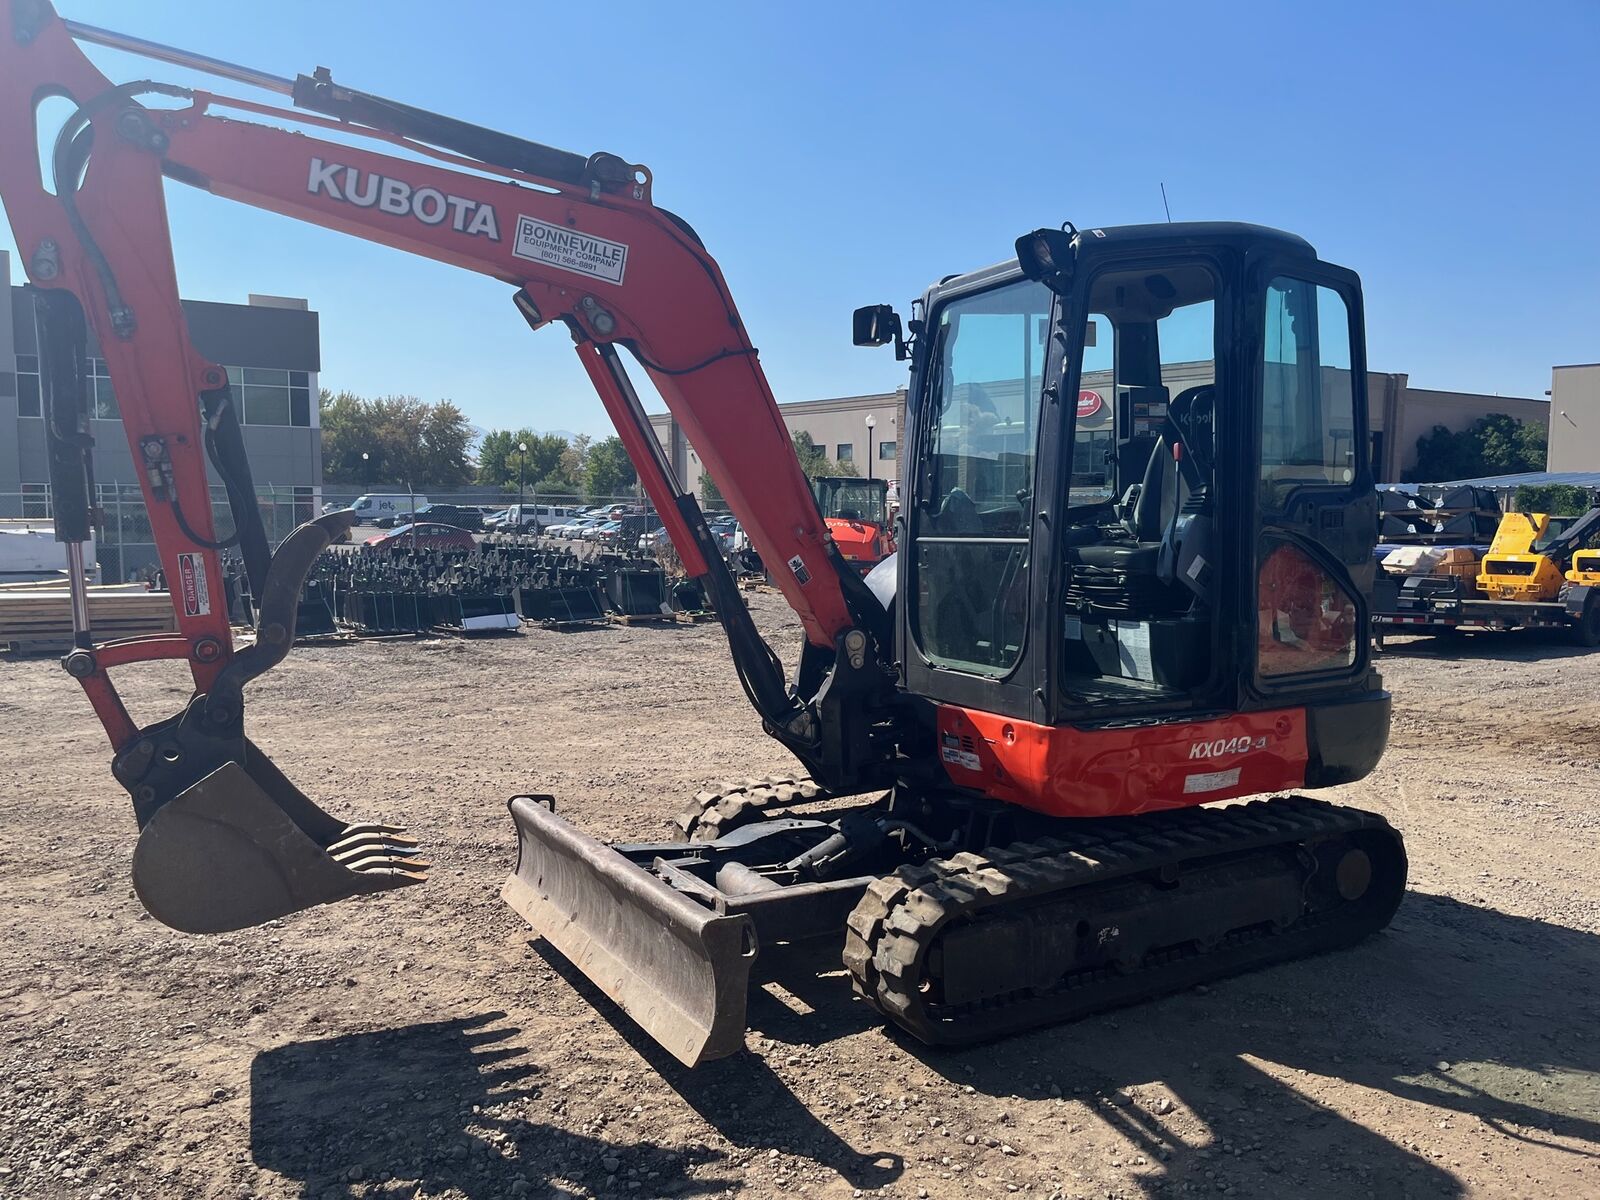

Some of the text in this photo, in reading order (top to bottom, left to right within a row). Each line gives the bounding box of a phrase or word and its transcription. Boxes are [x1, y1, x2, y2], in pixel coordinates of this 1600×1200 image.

[308, 158, 500, 240] KUBOTA
[523, 222, 622, 261] BONNEVILLE
[524, 236, 617, 268] EQUIPMENT COMPANY
[541, 249, 560, 263] (801)
[185, 568, 196, 602] DANGER
[1189, 735, 1267, 760] KX040-4
